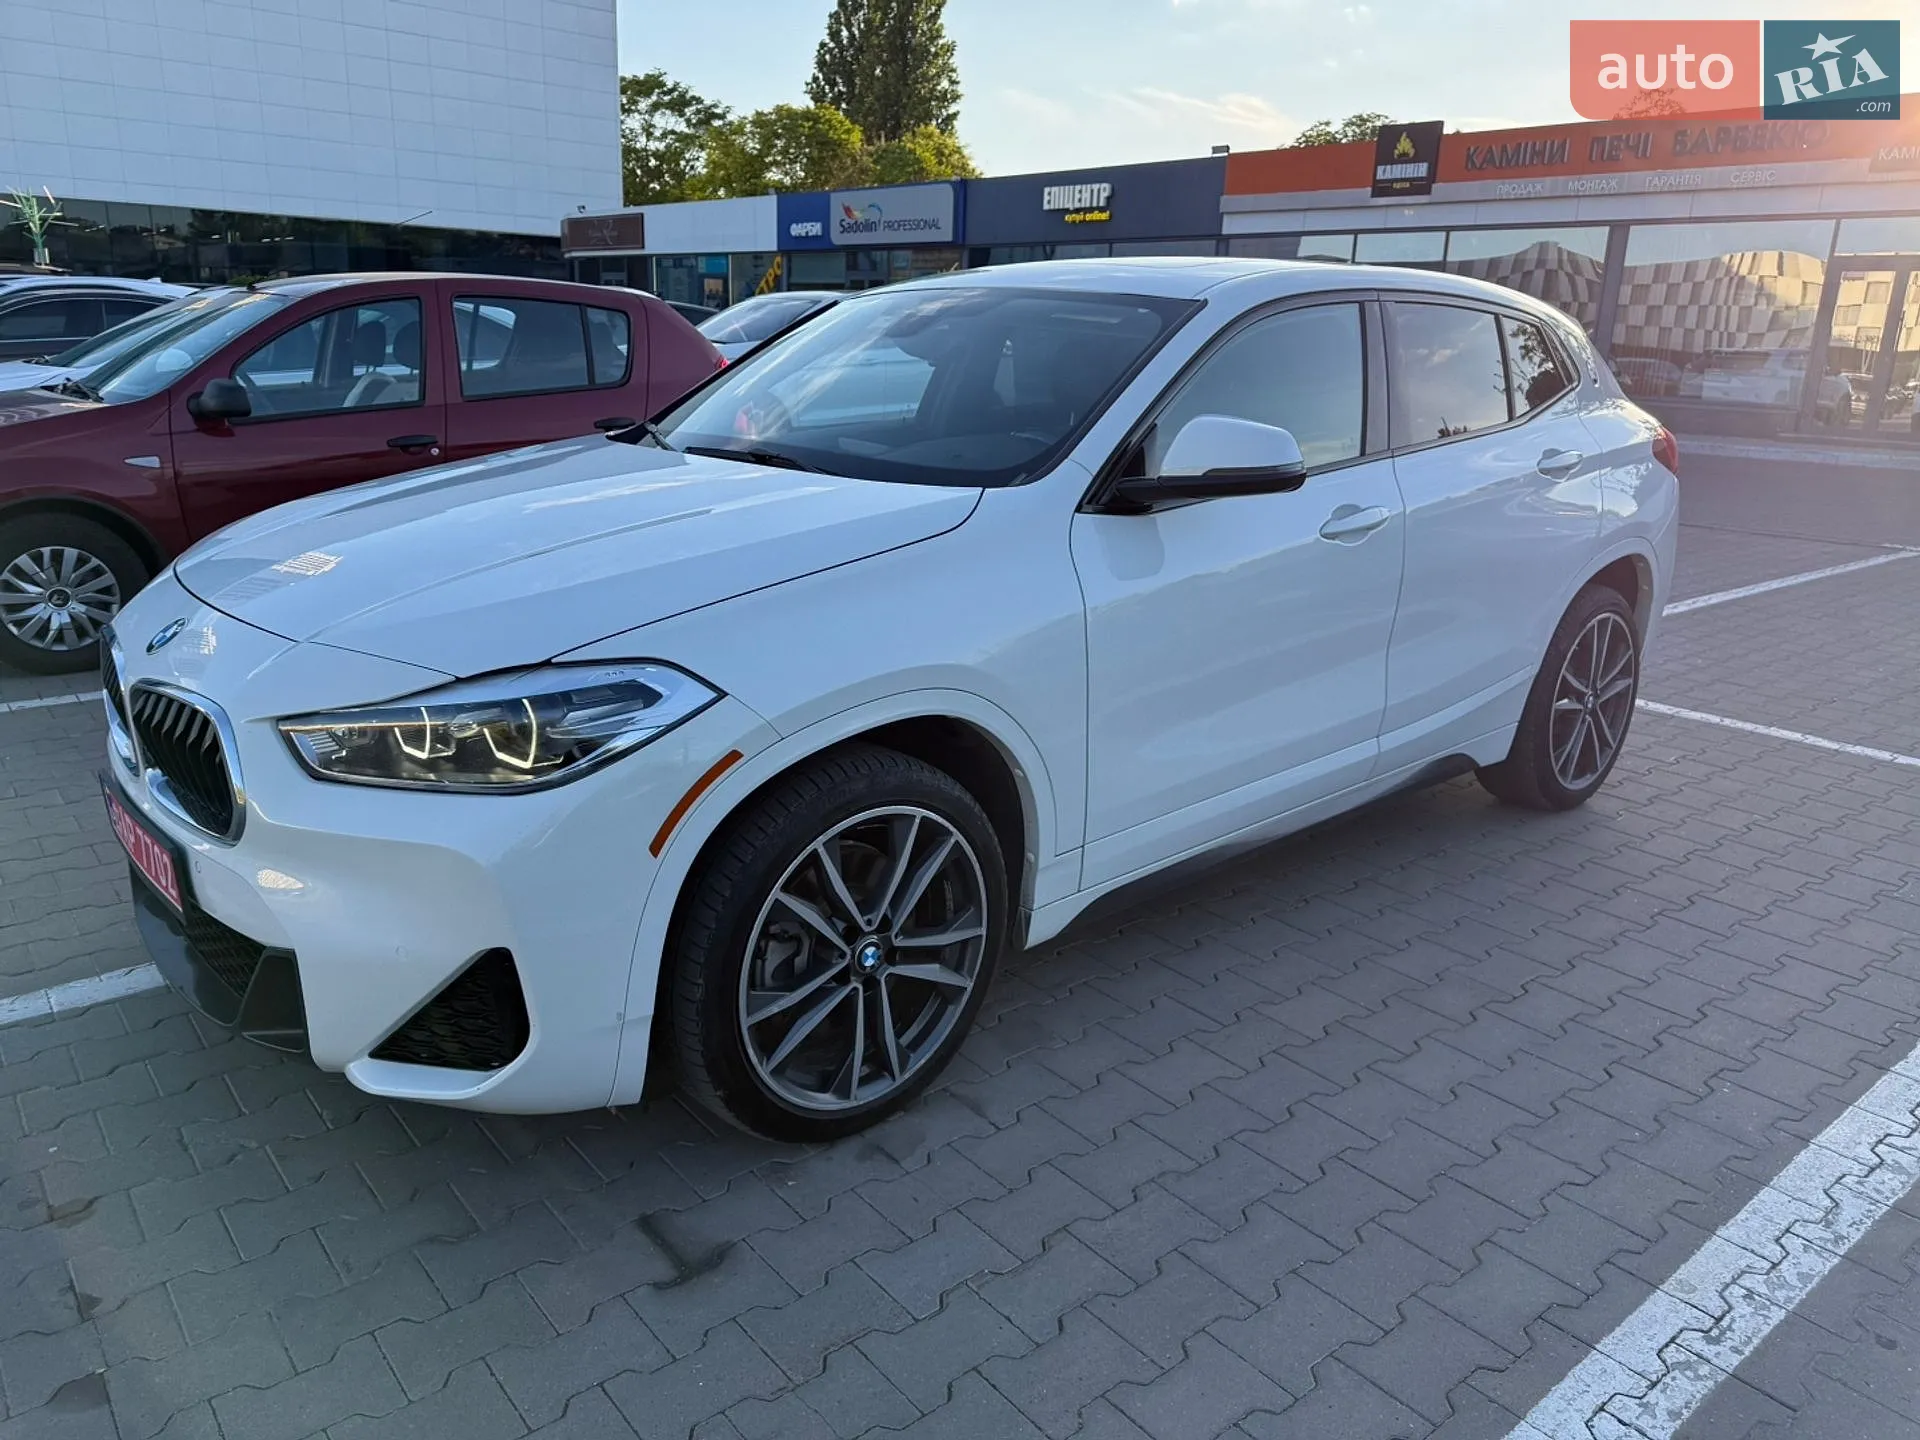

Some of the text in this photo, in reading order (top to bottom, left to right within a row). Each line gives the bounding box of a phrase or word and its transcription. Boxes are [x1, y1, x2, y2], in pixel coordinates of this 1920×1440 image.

[1465, 138, 1571, 171] КАМІНИ
[1588, 132, 1656, 163] ПЕЧІ
[1496, 170, 1777, 195] ПРОДАЖ МОНТАЖ ГАРАНТІЯ СЕРВІС
[1042, 182, 1112, 211] ЕПІЦЕНТР
[789, 222, 823, 237] ФАРБИ
[839, 218, 941, 235] Sadolin PROFESSIONAL
